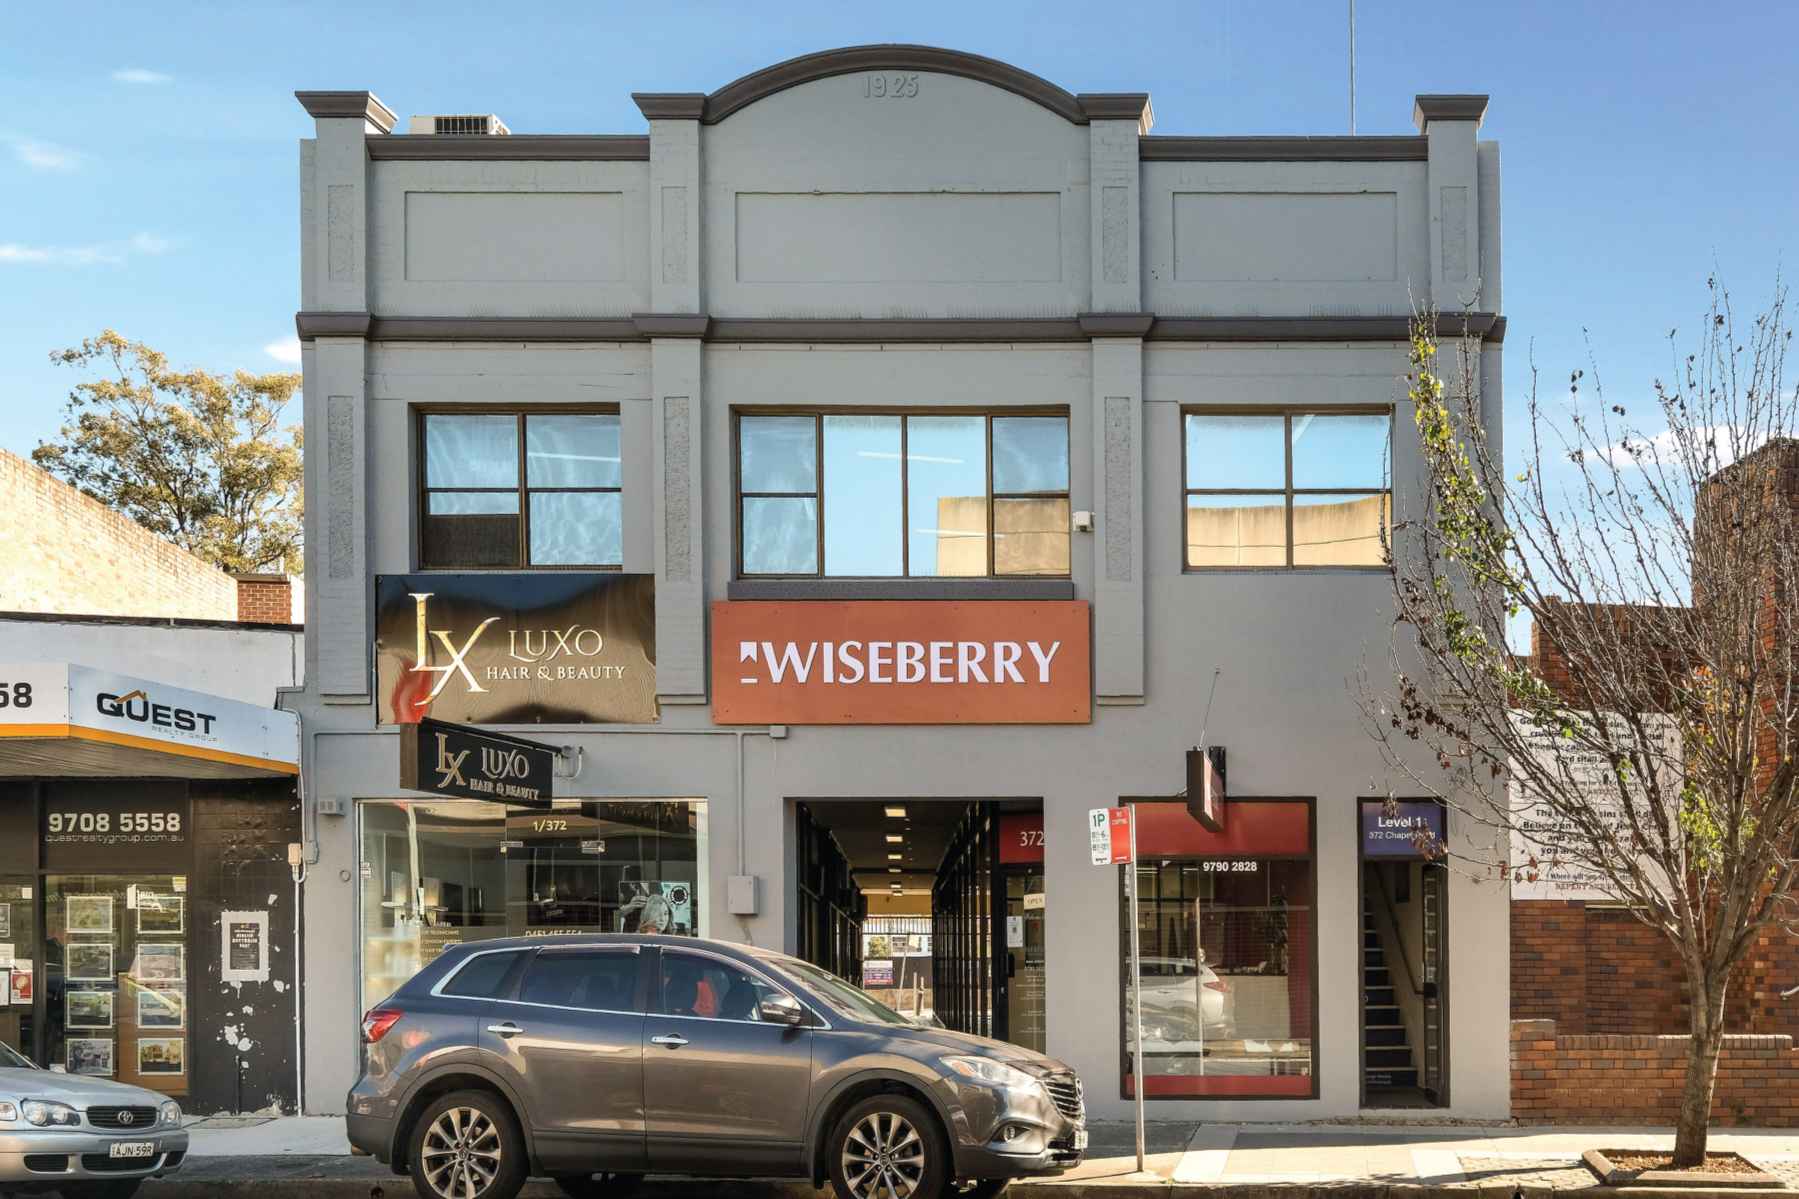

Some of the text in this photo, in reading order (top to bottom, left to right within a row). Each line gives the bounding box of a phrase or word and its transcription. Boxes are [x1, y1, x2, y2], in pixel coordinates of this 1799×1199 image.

[864, 73, 919, 98] 1925
[507, 624, 604, 663] LUXO
[761, 640, 1061, 684] WISEBERRY
[486, 666, 626, 681] HAIR & BEAUTY
[96, 691, 217, 735] QUEST
[480, 746, 530, 779] LUXO
[470, 778, 495, 793] HAIR
[506, 784, 540, 800] BEAUTY
[48, 813, 181, 832] 9708 5558
[532, 819, 568, 832] 1/372
[1378, 816, 1412, 828] Level
[1019, 831, 1046, 847] 372
[1368, 831, 1384, 839] 372
[1202, 861, 1258, 871] 9790 2828
